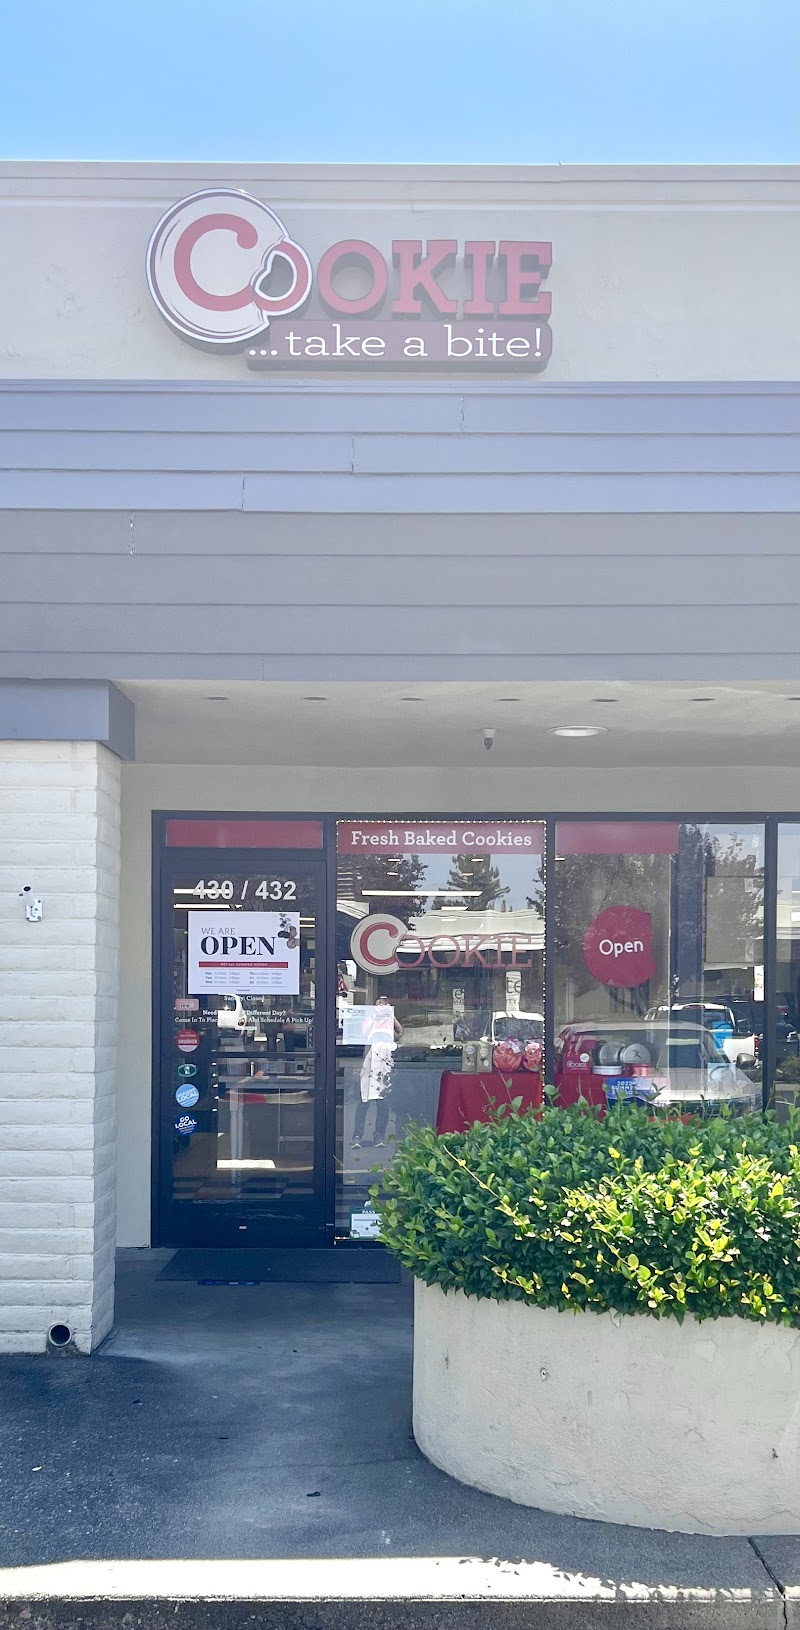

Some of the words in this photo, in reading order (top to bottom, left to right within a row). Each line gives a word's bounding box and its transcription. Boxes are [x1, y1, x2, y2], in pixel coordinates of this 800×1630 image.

[403, 333, 428, 356] a
[444, 324, 541, 357] bite!
[351, 830, 399, 846] Fresh
[404, 830, 457, 846] Baked
[462, 830, 532, 846] Cookies
[193, 880, 234, 900] 430
[255, 880, 297, 900] 432
[201, 927, 217, 935] WE
[218, 927, 236, 935] ARE
[200, 935, 276, 956] OPEN
[359, 921, 533, 969] COOKIE
[599, 939, 644, 957] Open
[174, 1119, 198, 1129] LOCAL
[180, 1115, 190, 1123] GO
